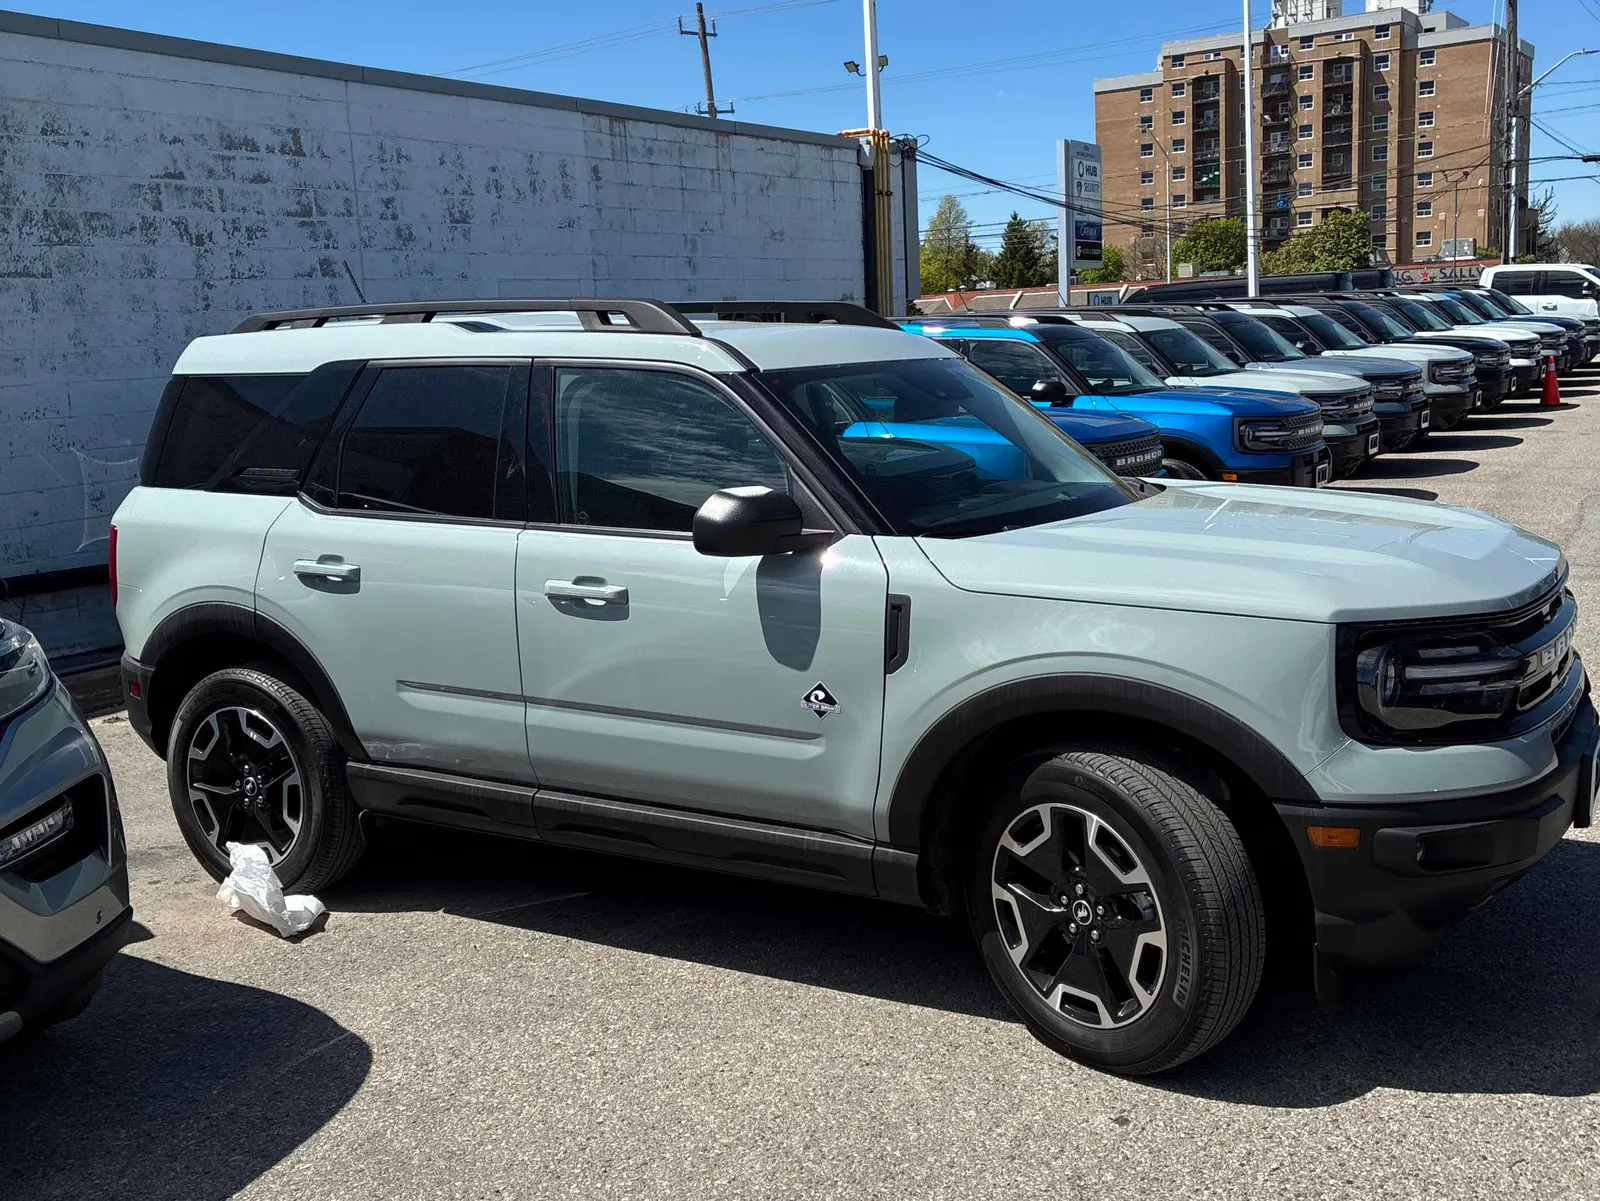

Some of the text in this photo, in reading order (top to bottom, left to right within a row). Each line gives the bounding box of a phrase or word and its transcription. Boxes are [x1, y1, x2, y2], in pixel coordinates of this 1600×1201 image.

[1085, 164, 1098, 177] HUB
[1439, 266, 1485, 280] SALLY
[1100, 296, 1113, 305] HUB
[1116, 450, 1162, 466] BRONCO
[1176, 917, 1192, 1005] MICHELIN
